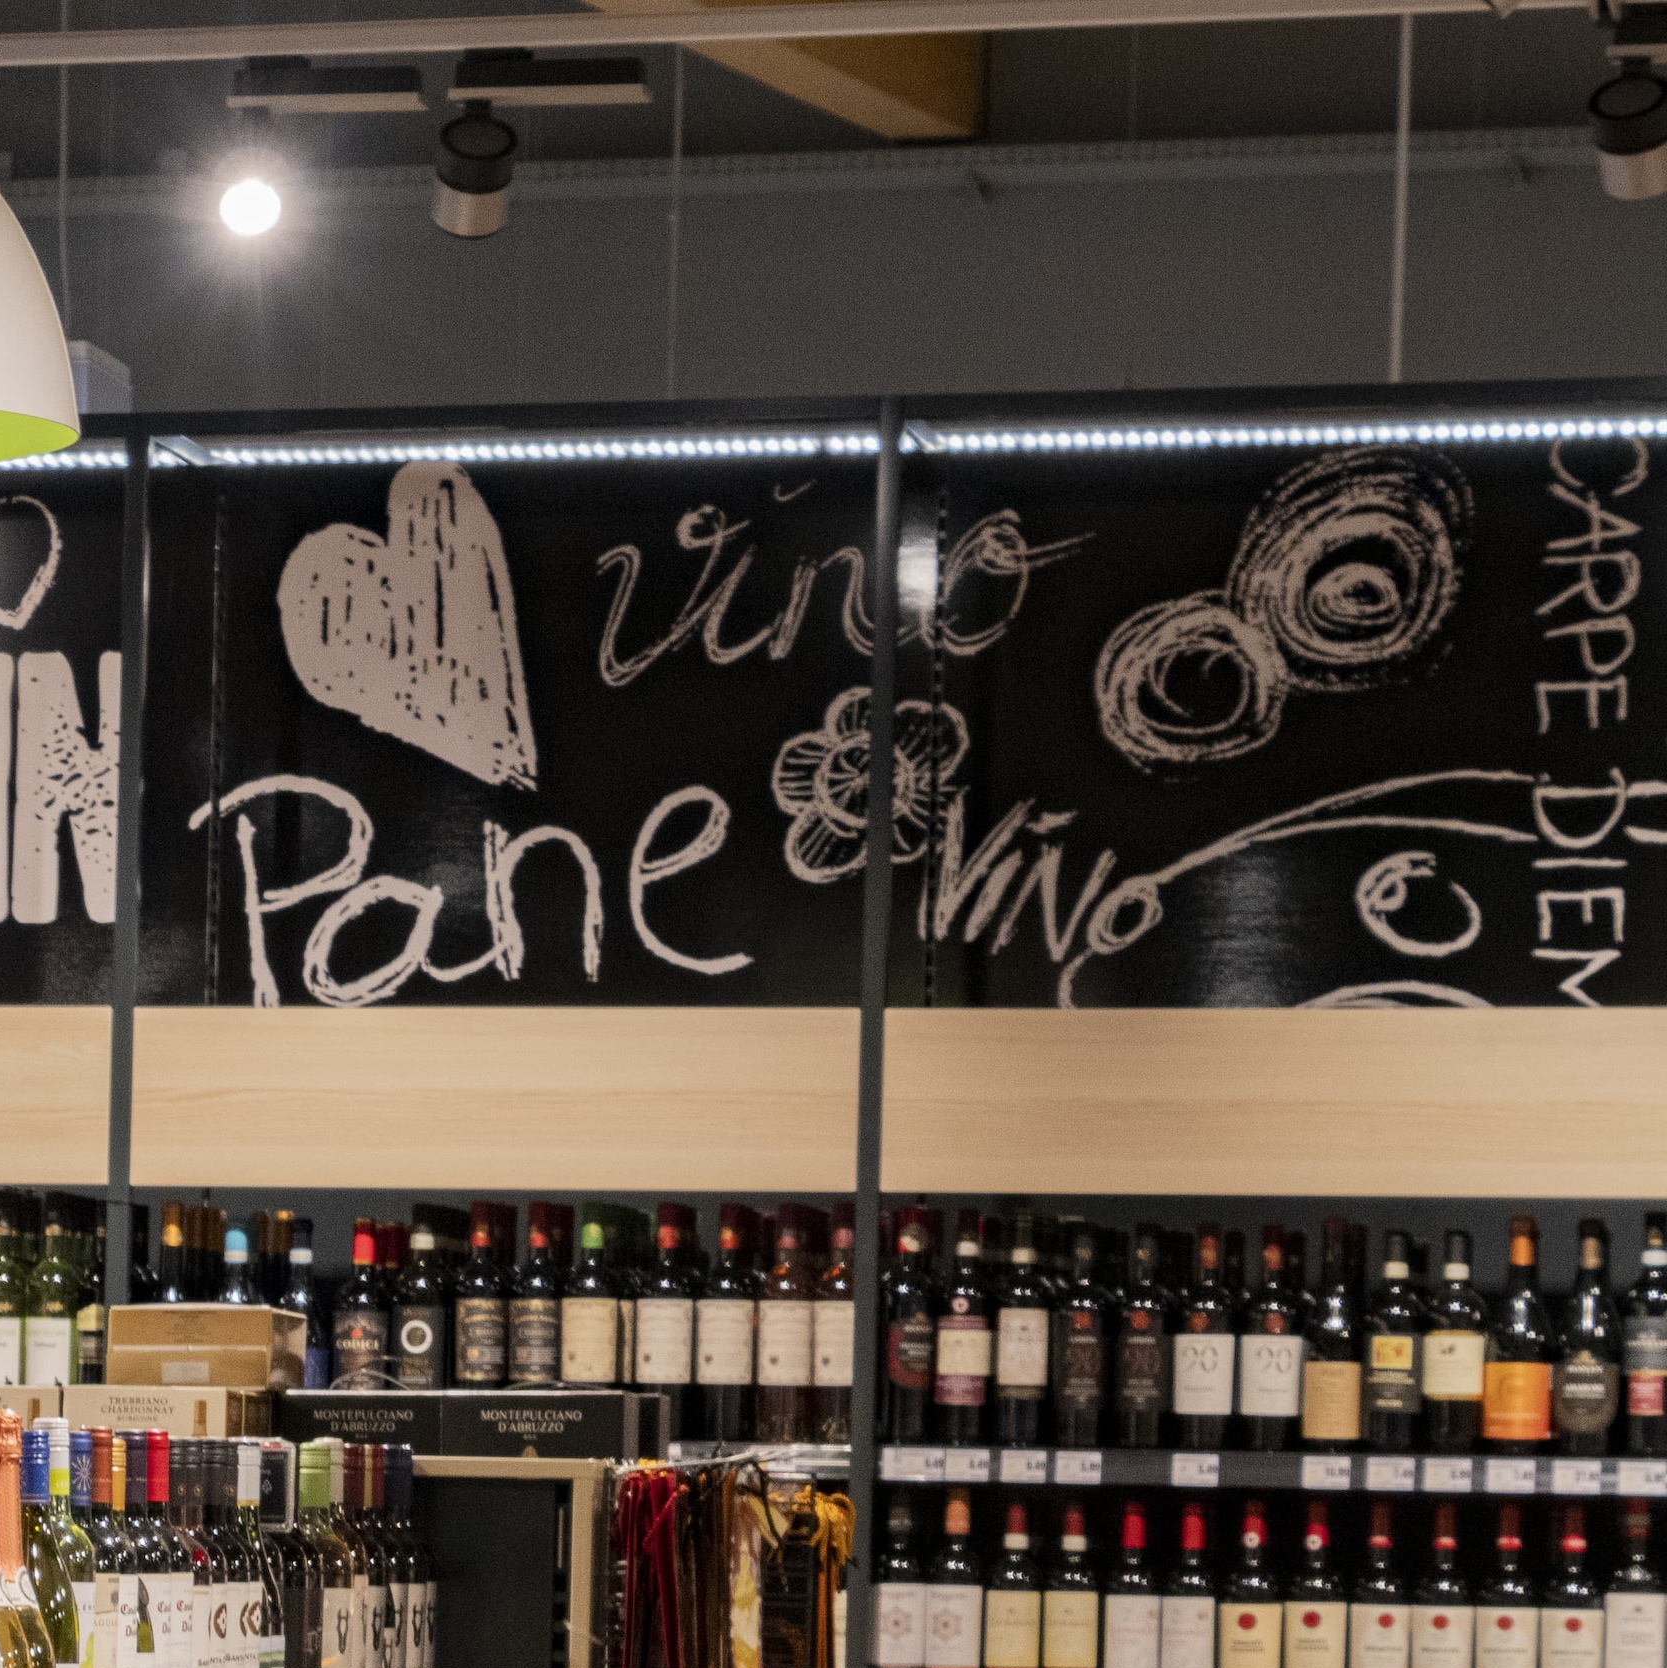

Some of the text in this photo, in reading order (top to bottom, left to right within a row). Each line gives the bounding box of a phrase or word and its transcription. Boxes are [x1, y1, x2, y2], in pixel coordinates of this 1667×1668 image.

[1535, 437, 1649, 735] CARPE
[189, 772, 754, 1008] Pane
[312, 1408, 415, 1421] MONTEPULCIANO
[479, 1408, 583, 1421] MONTEPULCIANO
[329, 1420, 396, 1433] D'ABRUZZO
[498, 1420, 565, 1433] D'ABRUZZO
